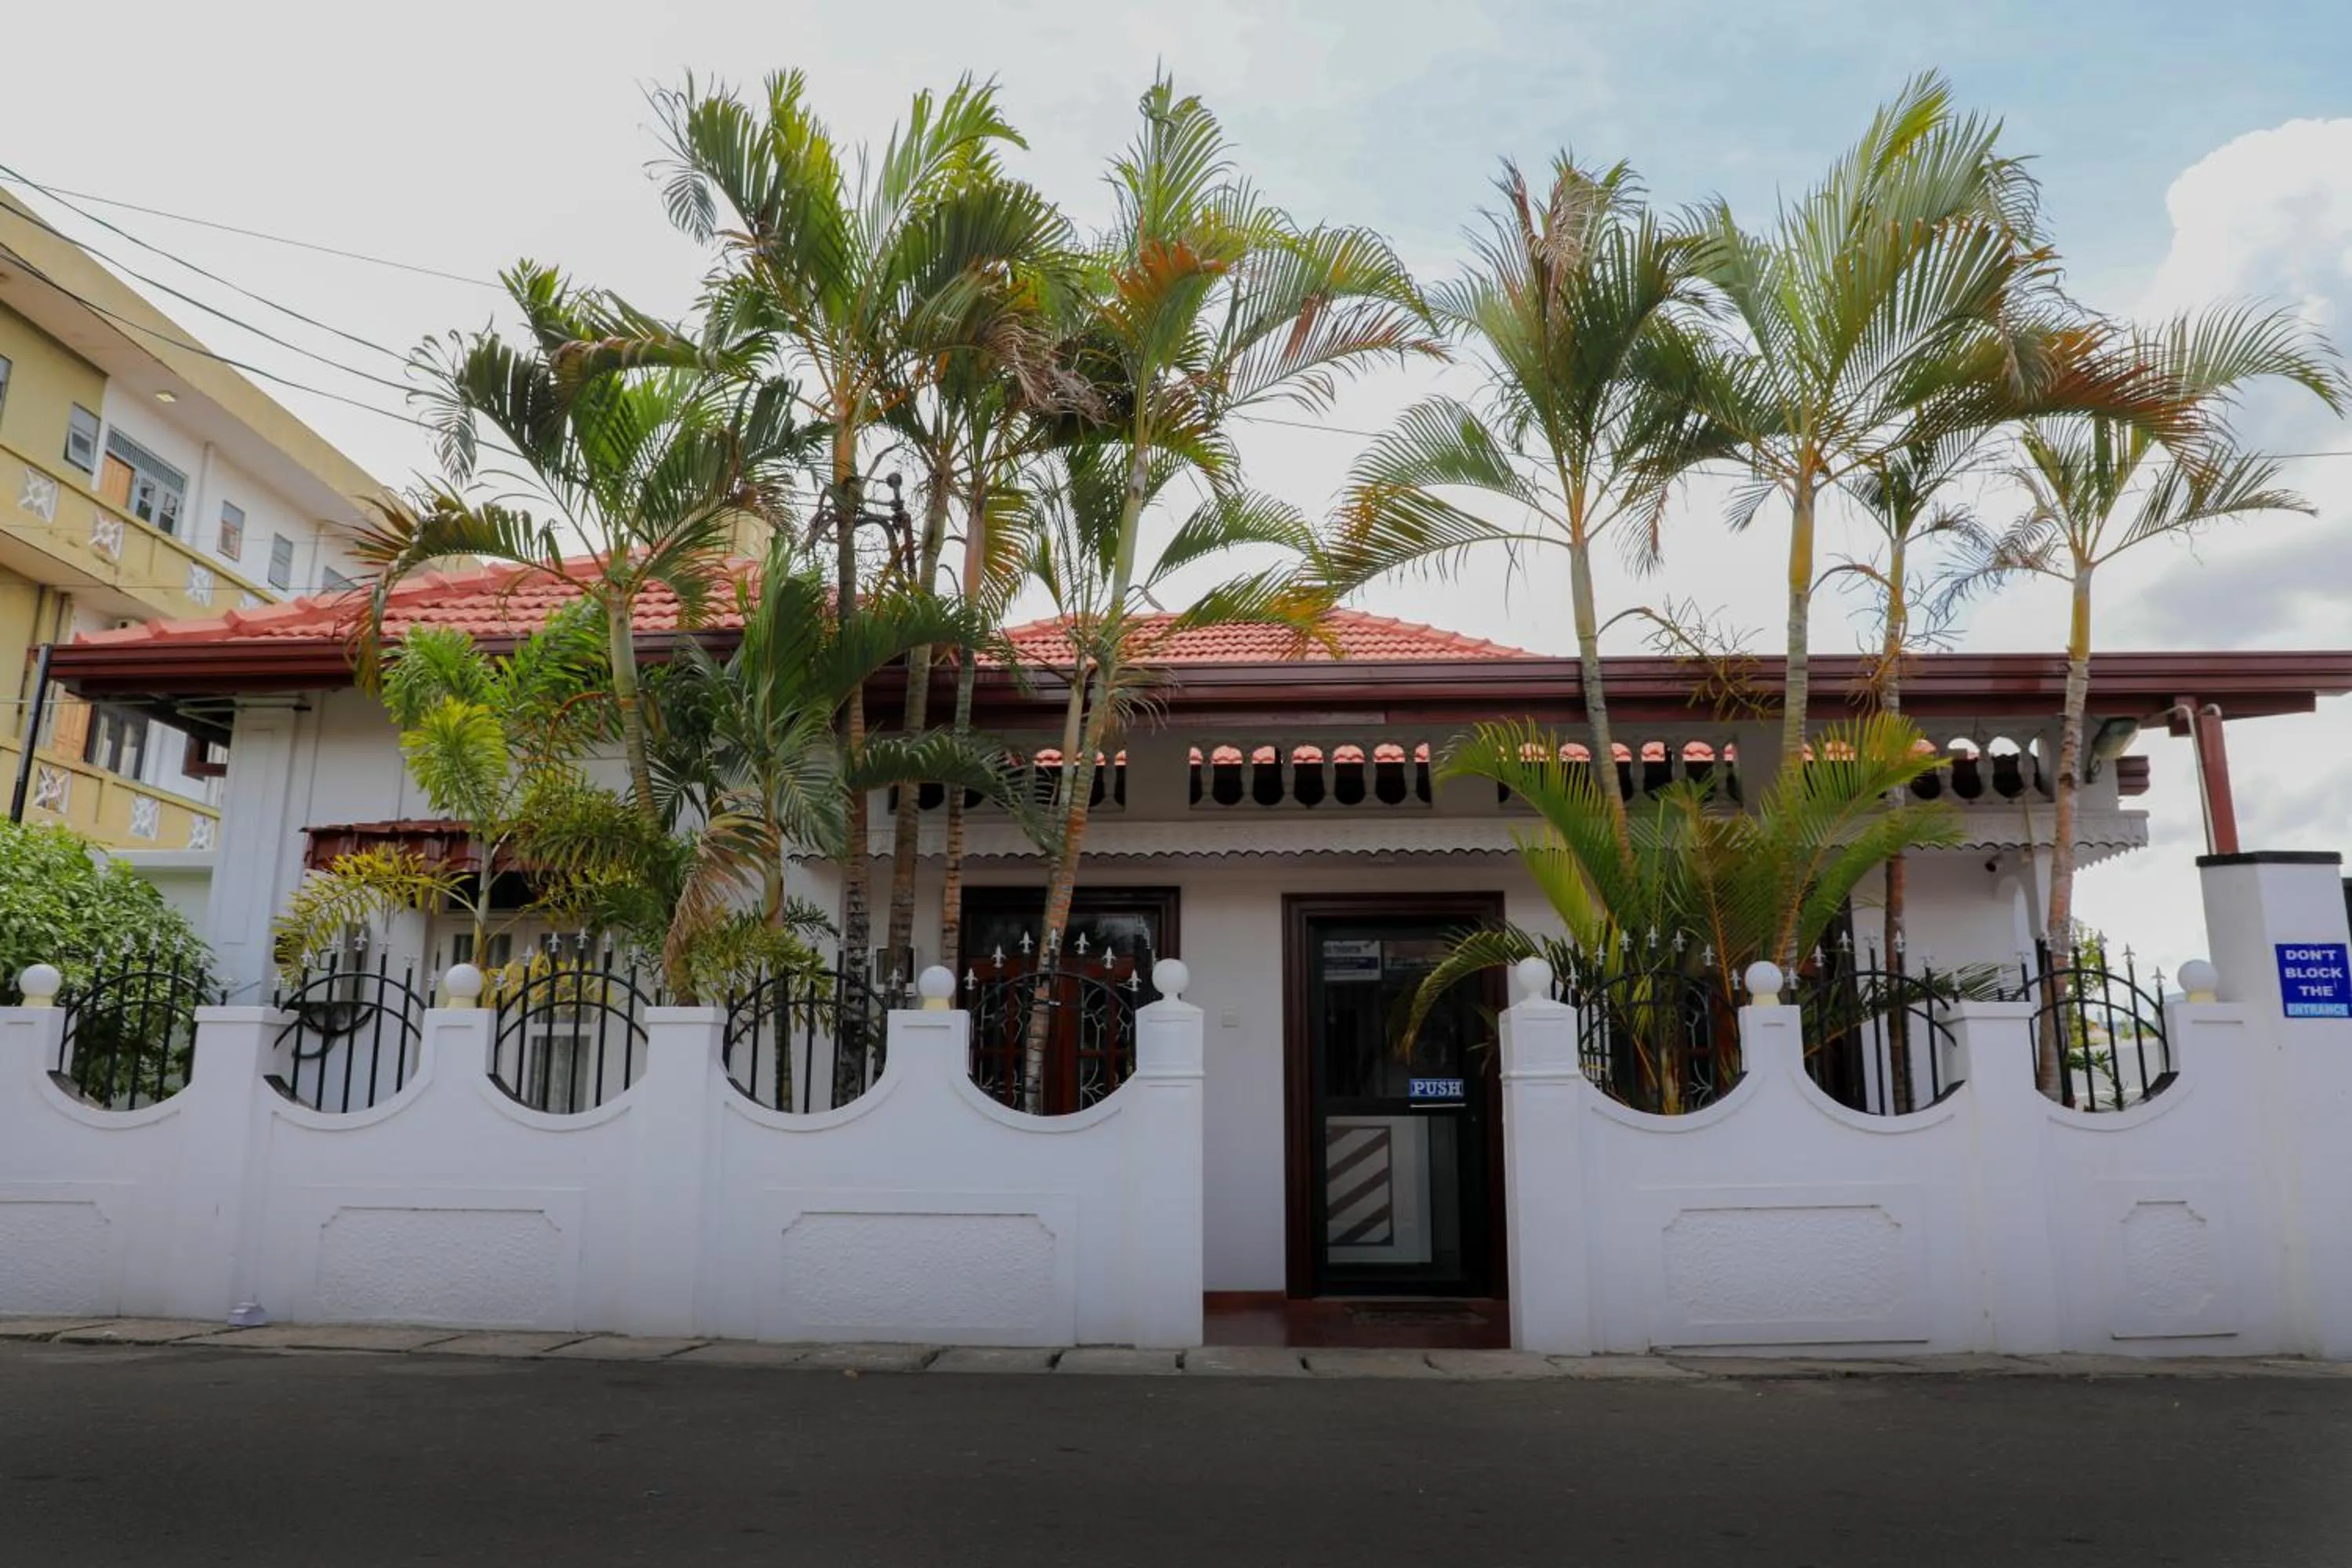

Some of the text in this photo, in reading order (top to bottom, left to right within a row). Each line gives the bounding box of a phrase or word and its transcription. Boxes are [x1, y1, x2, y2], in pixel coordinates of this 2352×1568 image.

[2285, 949, 2336, 960] DON'T
[2285, 967, 2343, 978] BLOCK
[2298, 985, 2334, 996] THE
[2287, 1004, 2349, 1016] ENTRANCE
[1413, 1081, 1462, 1097] PUSH
